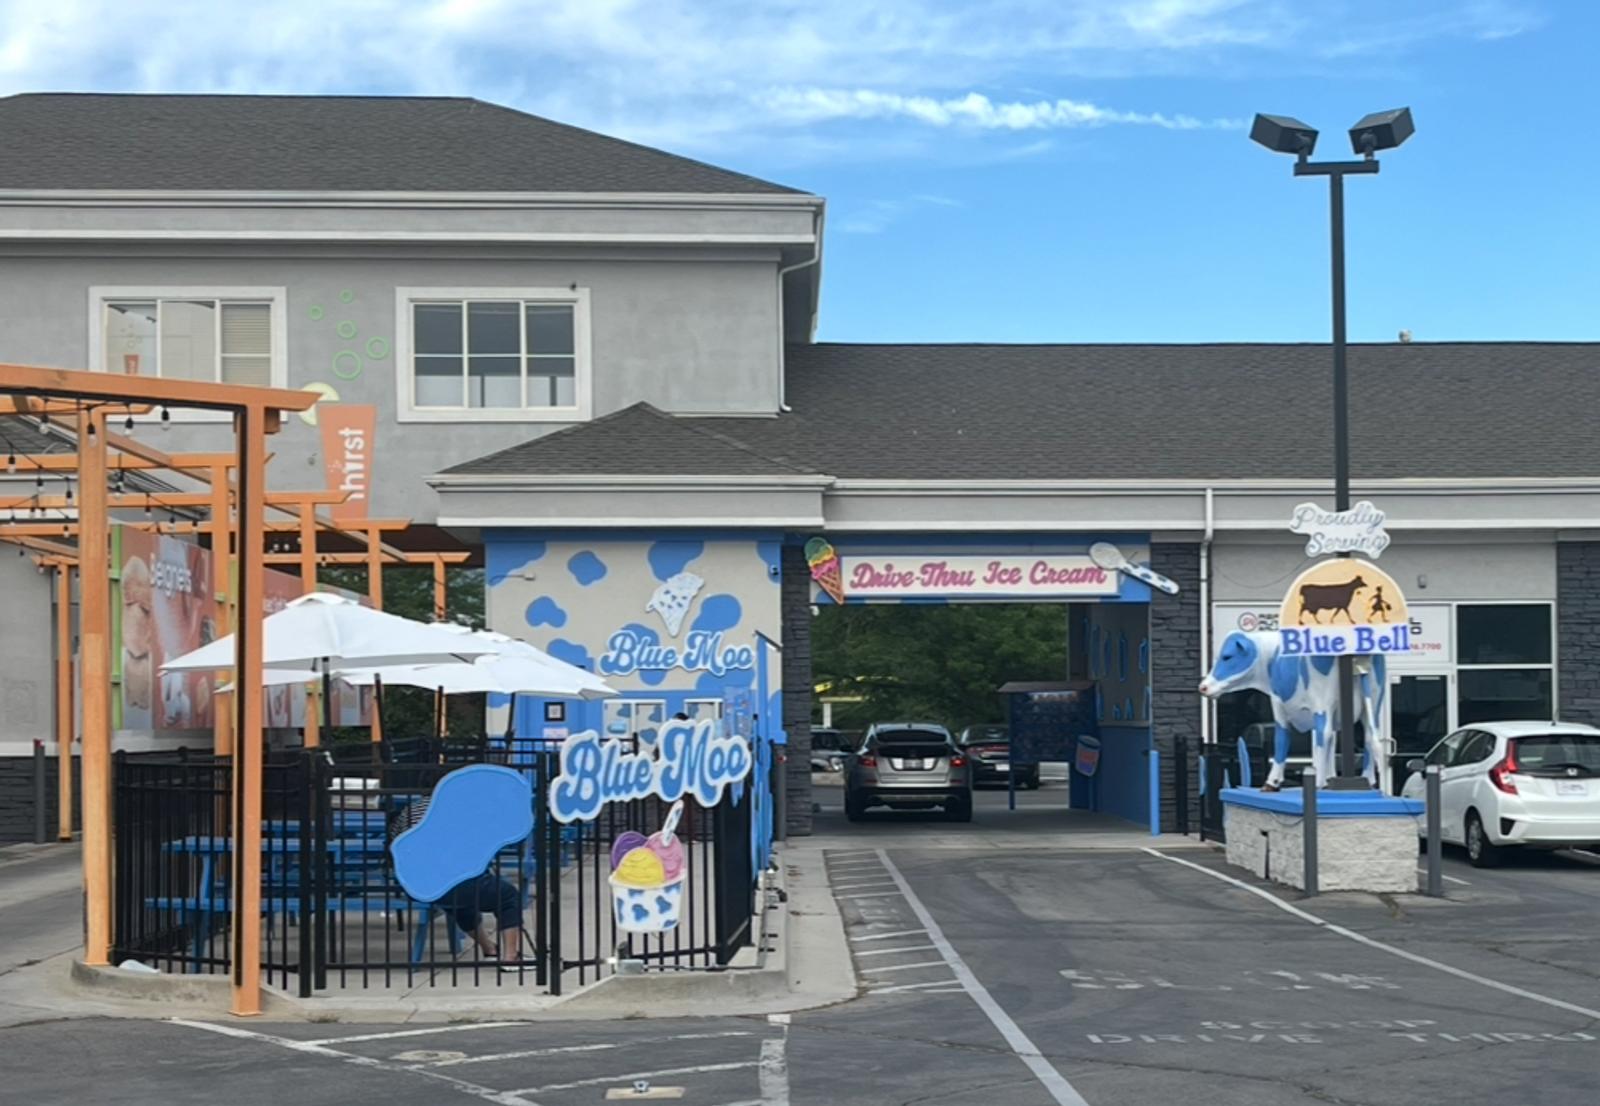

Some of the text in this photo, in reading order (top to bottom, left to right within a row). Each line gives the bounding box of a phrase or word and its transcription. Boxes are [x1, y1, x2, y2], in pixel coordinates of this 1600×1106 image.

[1290, 502, 1385, 534] Proudly
[1305, 532, 1389, 558] Serving
[850, 560, 1107, 589] Drive-Thru Ice Cream
[600, 631, 753, 676] Blue Moo
[1281, 625, 1411, 655] Blue Bell
[555, 726, 747, 816] Blue Moo
[1085, 1032, 1597, 1043] DRIVE THRU
[1200, 1019, 1438, 1030] SCOOP
